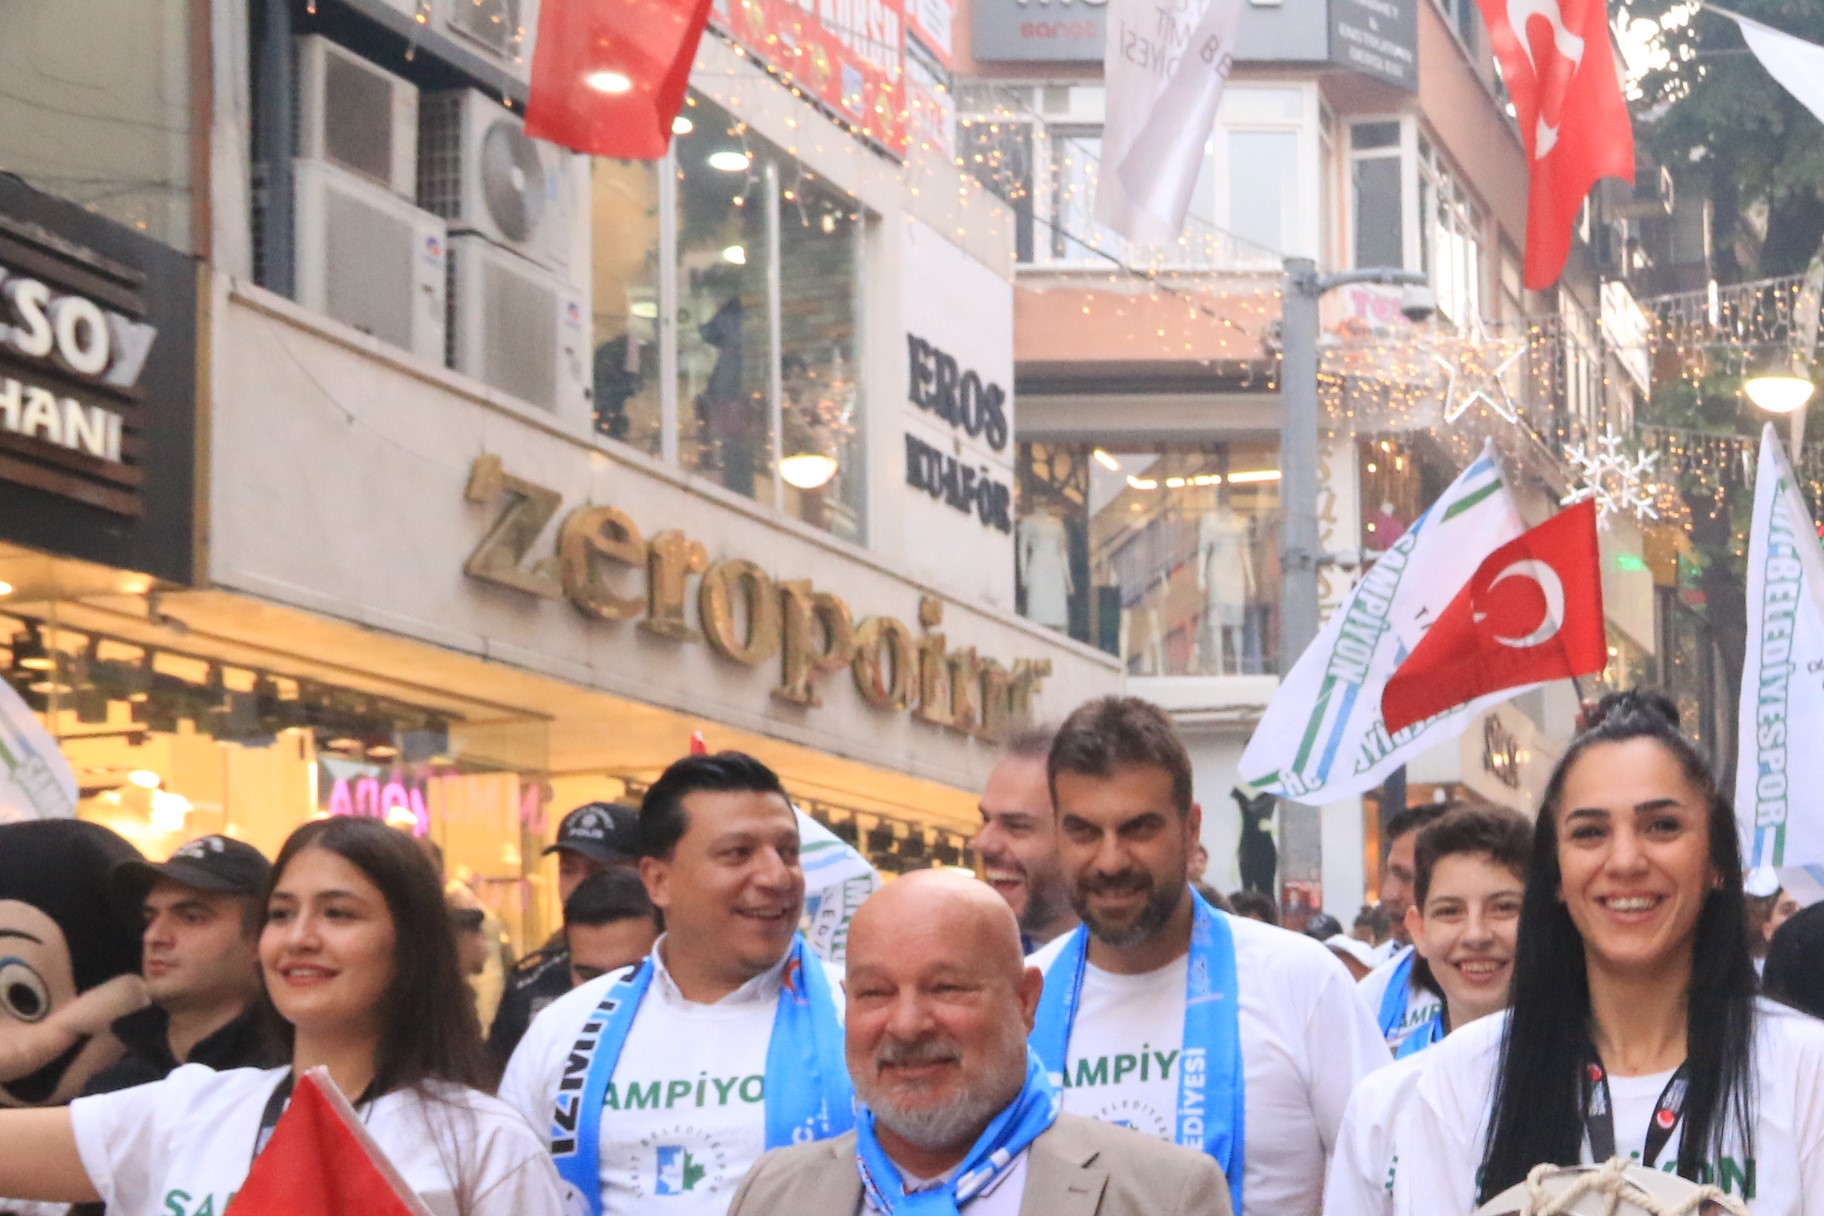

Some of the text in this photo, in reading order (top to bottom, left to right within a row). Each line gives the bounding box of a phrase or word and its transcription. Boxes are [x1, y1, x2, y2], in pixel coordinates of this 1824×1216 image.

[906, 332, 1008, 451] EROS
[1063, 1043, 1179, 1089] AMPİY
[602, 1070, 765, 1111] AMPİYO
